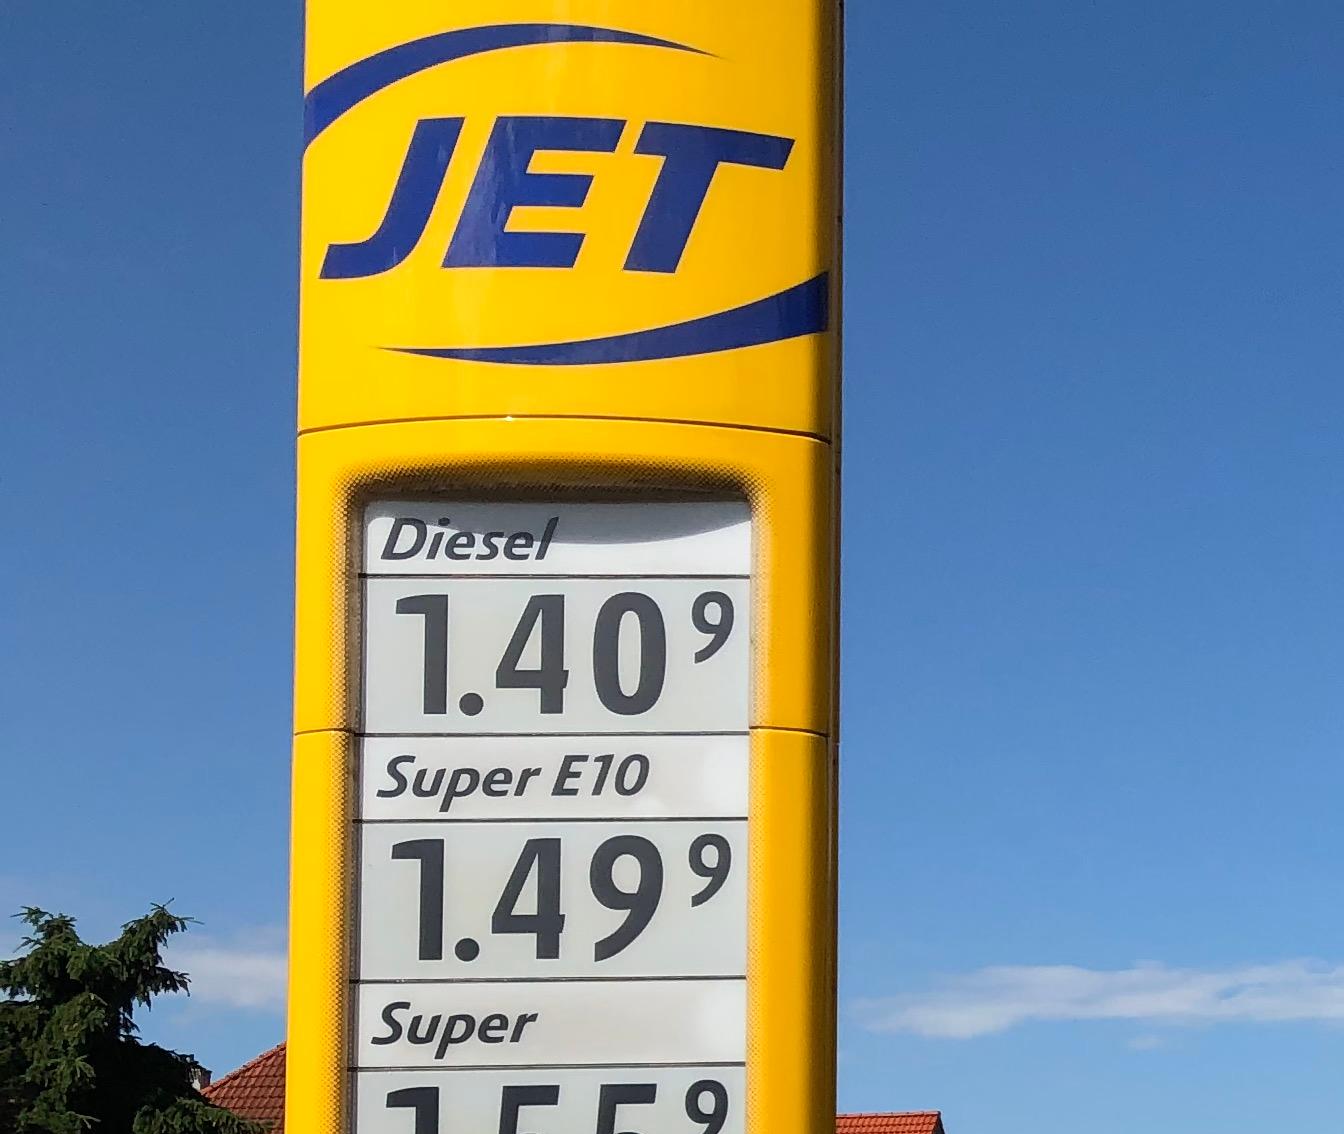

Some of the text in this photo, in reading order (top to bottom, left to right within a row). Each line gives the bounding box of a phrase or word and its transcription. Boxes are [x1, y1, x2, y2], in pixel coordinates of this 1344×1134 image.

[319, 116, 793, 280] JET
[380, 516, 560, 562] Diesel
[395, 590, 735, 717] 1.409
[376, 753, 650, 813] Super E10
[391, 833, 732, 963] 1.499
[370, 1001, 539, 1060] Super
